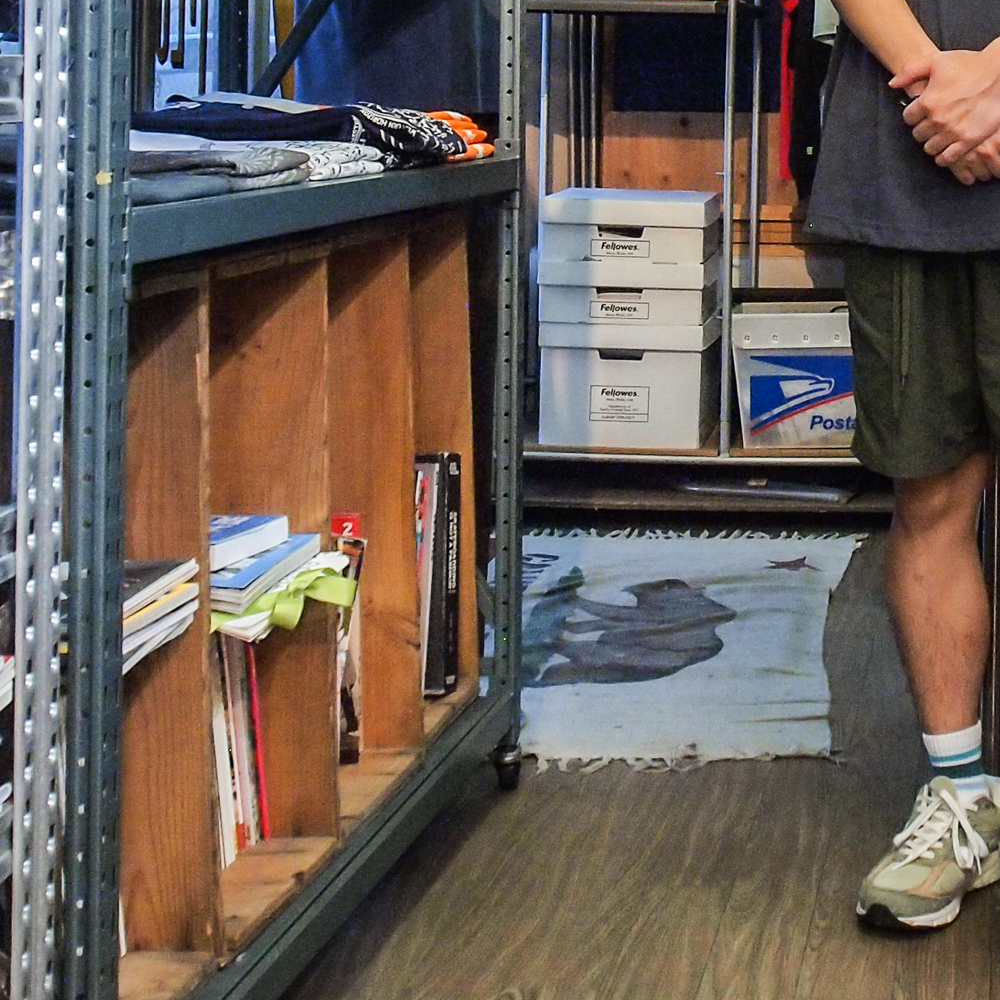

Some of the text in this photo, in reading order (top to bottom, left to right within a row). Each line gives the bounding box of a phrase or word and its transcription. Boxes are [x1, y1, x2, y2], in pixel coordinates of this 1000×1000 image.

[600, 241, 639, 251] Fellowes
[600, 303, 638, 313] Fellowes
[600, 388, 638, 398] Fellowes
[342, 521, 354, 537] 2
